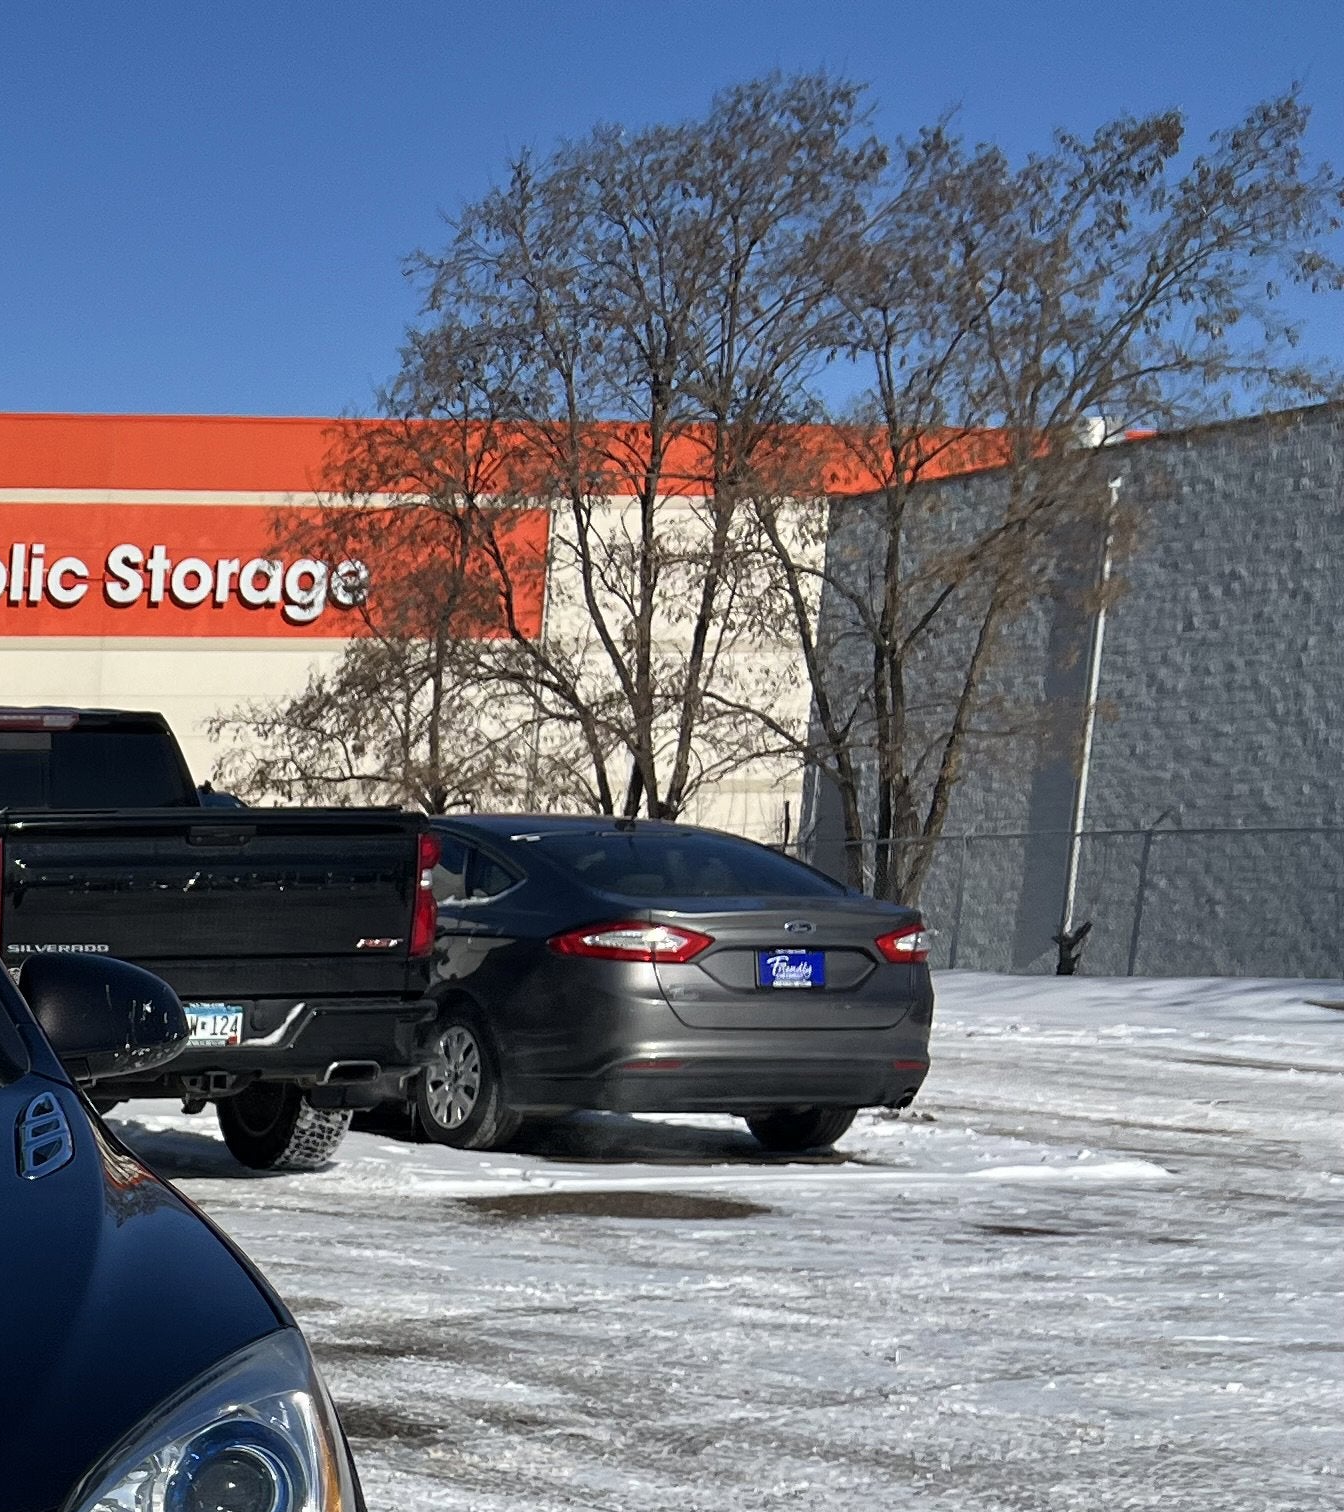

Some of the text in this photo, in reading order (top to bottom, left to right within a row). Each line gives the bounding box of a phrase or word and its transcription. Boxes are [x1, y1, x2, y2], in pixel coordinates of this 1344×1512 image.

[104, 542, 370, 623] Storage
[7, 943, 110, 953] SILVERADO
[766, 954, 813, 978] Friendly
